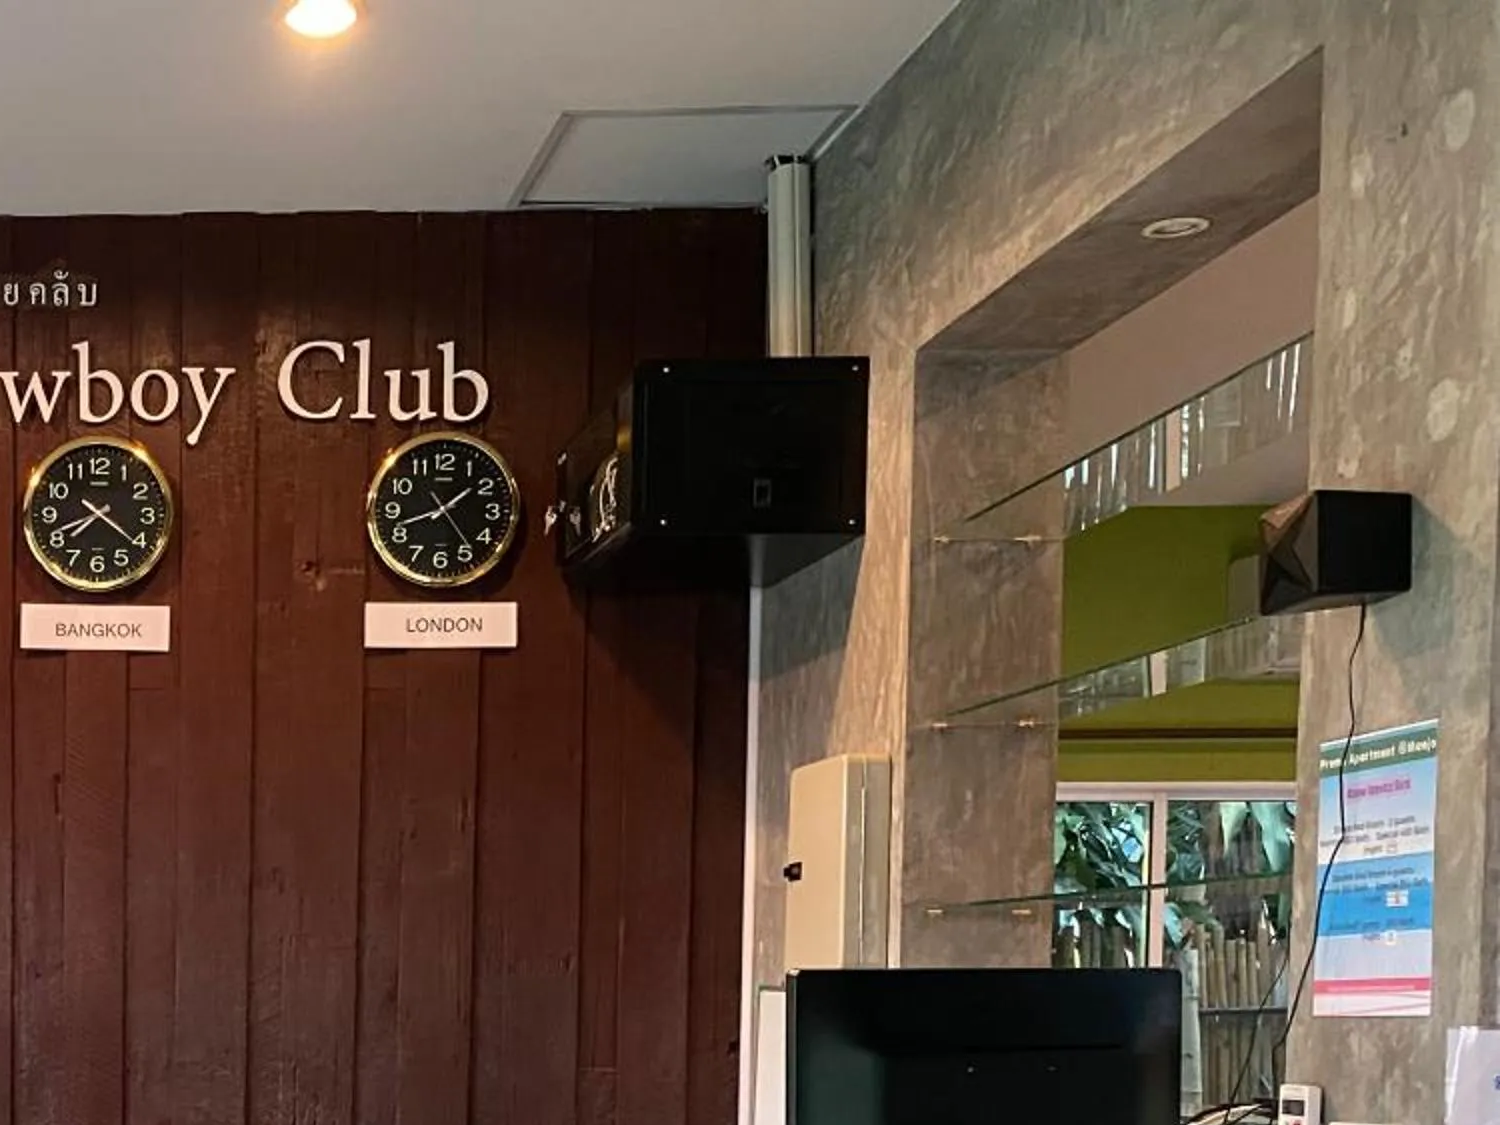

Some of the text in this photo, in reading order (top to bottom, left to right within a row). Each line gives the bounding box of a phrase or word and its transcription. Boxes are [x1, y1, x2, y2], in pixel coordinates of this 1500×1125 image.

[277, 338, 489, 423] Club
[89, 458, 110, 475] 12
[412, 459, 427, 476] 11
[435, 453, 456, 471] 12
[67, 464, 83, 480] 11
[49, 483, 68, 500] 10
[133, 484, 148, 500] 2
[392, 479, 412, 495] 10
[478, 479, 494, 496] 2
[41, 507, 57, 523] 9
[140, 507, 155, 524] 3
[385, 502, 400, 519] 9
[485, 503, 501, 520] 3
[50, 532, 65, 548] 8
[132, 532, 147, 548] 4
[392, 527, 407, 543] 8
[476, 528, 492, 544] 4
[66, 550, 81, 567] 7
[113, 550, 129, 566] 5
[409, 545, 424, 562] 7
[433, 552, 448, 569] 6
[458, 545, 473, 562] 5
[90, 556, 105, 573] 6
[56, 624, 142, 637] BANGKOK
[406, 618, 483, 632] LONDON
[1349, 745, 1395, 767] Apartment
